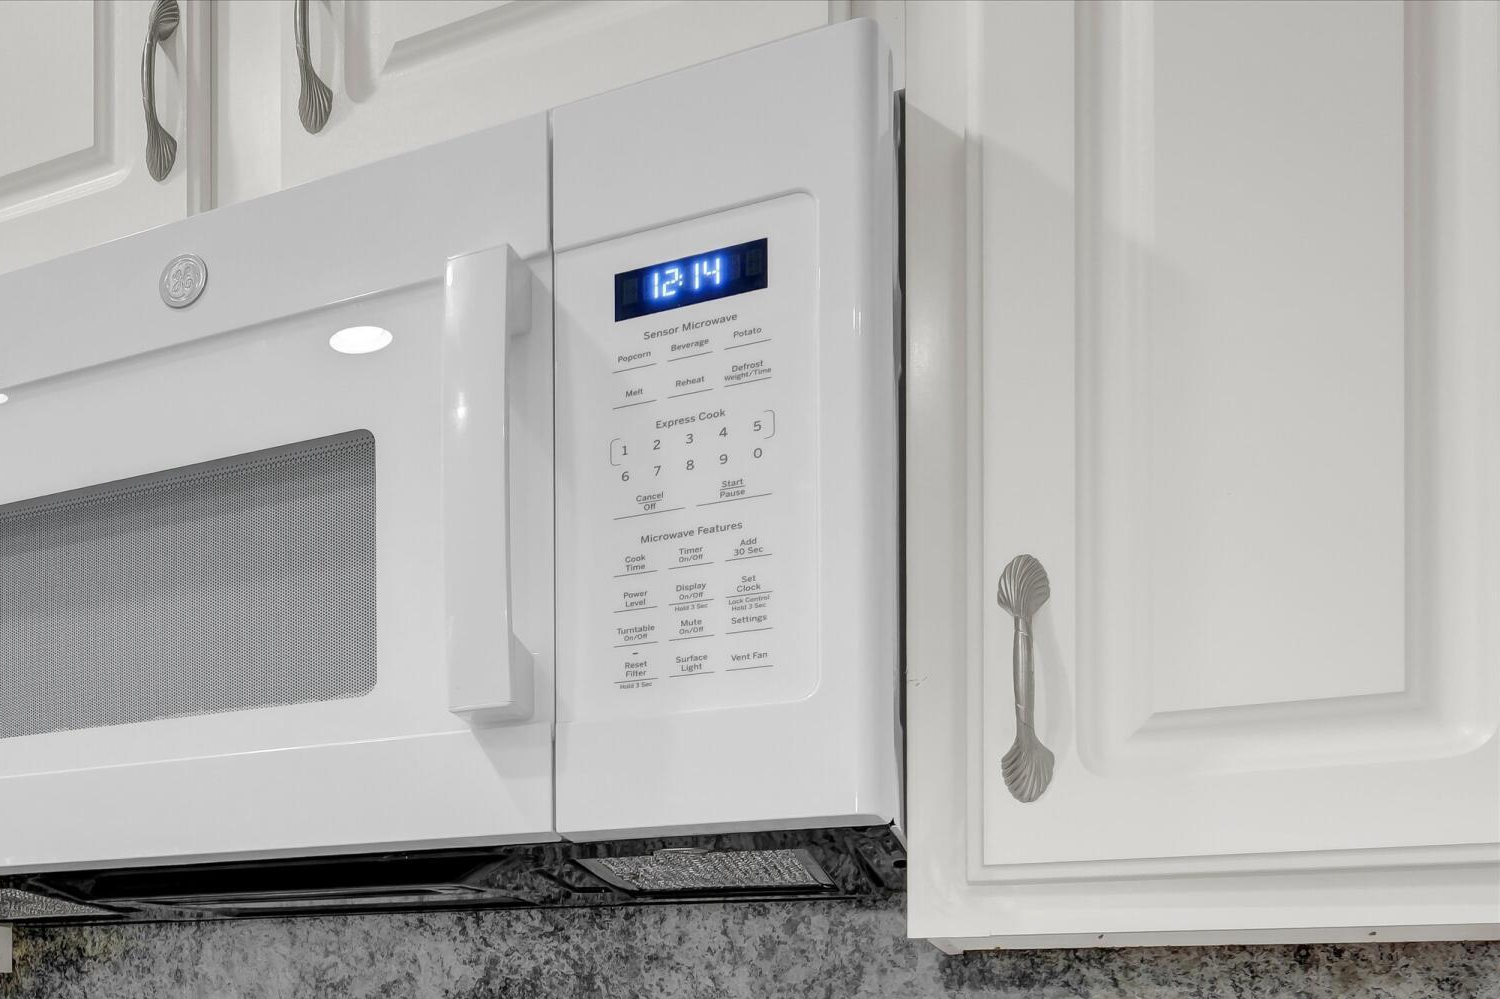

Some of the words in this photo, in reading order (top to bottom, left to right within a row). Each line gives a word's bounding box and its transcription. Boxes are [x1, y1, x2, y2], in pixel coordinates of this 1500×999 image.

[654, 258, 720, 299] 12:14
[643, 326, 679, 341] Sensor
[682, 313, 738, 332] Microwave
[733, 326, 762, 339] Potato
[670, 337, 709, 352] Beverage
[617, 350, 652, 364] Popcorn
[731, 359, 764, 373] Defrost
[724, 366, 772, 382] Weight/Time
[675, 375, 705, 388] Reheat
[625, 388, 643, 398] Melt
[655, 415, 696, 430] Express
[698, 408, 726, 421] Cook
[622, 446, 628, 456] 1
[653, 440, 661, 450] 2
[686, 433, 693, 444] 3
[719, 427, 728, 438] 4
[753, 420, 762, 431] 5
[621, 471, 630, 482] 6
[653, 465, 662, 476] 7
[686, 460, 694, 471] 8
[719, 454, 728, 464] 9
[753, 448, 762, 458] 0
[721, 478, 744, 488] Start
[636, 492, 664, 502] Cancel
[719, 488, 746, 498] Pause
[643, 502, 656, 511] Off
[640, 527, 695, 544] Microwave
[697, 521, 743, 535] Features
[740, 537, 757, 547] Add
[678, 546, 703, 555] Timer
[734, 548, 745, 556] 30
[748, 546, 764, 554] Sec
[625, 554, 645, 563] Cook
[678, 554, 703, 563] On/Off
[626, 563, 645, 572] Time
[741, 575, 756, 583] Set
[675, 582, 706, 593] Display
[736, 583, 761, 592] Clock
[623, 590, 647, 600] Power
[678, 592, 703, 600] On/Off
[625, 599, 646, 608] Level
[680, 618, 702, 627] Mute
[731, 614, 767, 625] Settings
[617, 624, 655, 634] Turntable
[678, 626, 703, 635] On/Off
[623, 633, 647, 642] On/Off
[675, 653, 708, 664] Surface
[731, 652, 750, 662] Vent
[752, 651, 767, 659] Fan
[624, 660, 647, 669] Reset
[681, 663, 702, 673] Light
[625, 669, 647, 678] Filter
